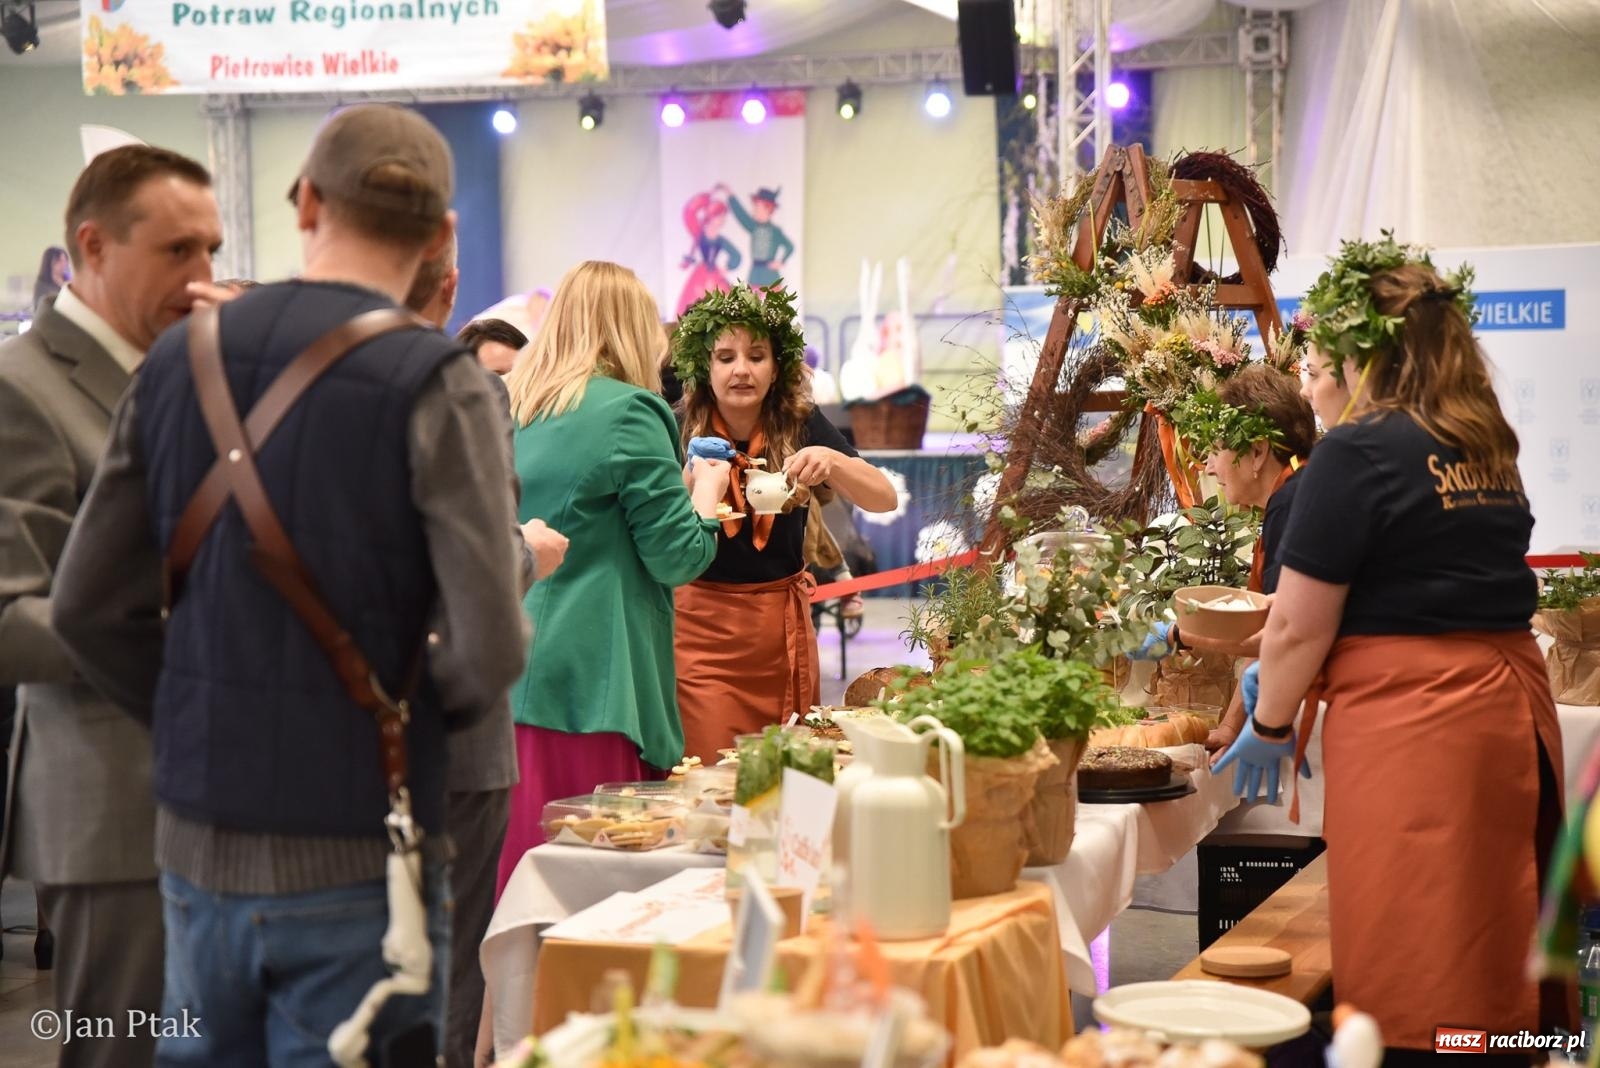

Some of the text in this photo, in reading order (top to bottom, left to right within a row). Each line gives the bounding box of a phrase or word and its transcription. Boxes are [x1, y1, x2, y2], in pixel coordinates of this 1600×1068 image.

[172, 0, 499, 29] Potraw Regionalnych
[210, 50, 399, 80] Pietrowice Wielkie
